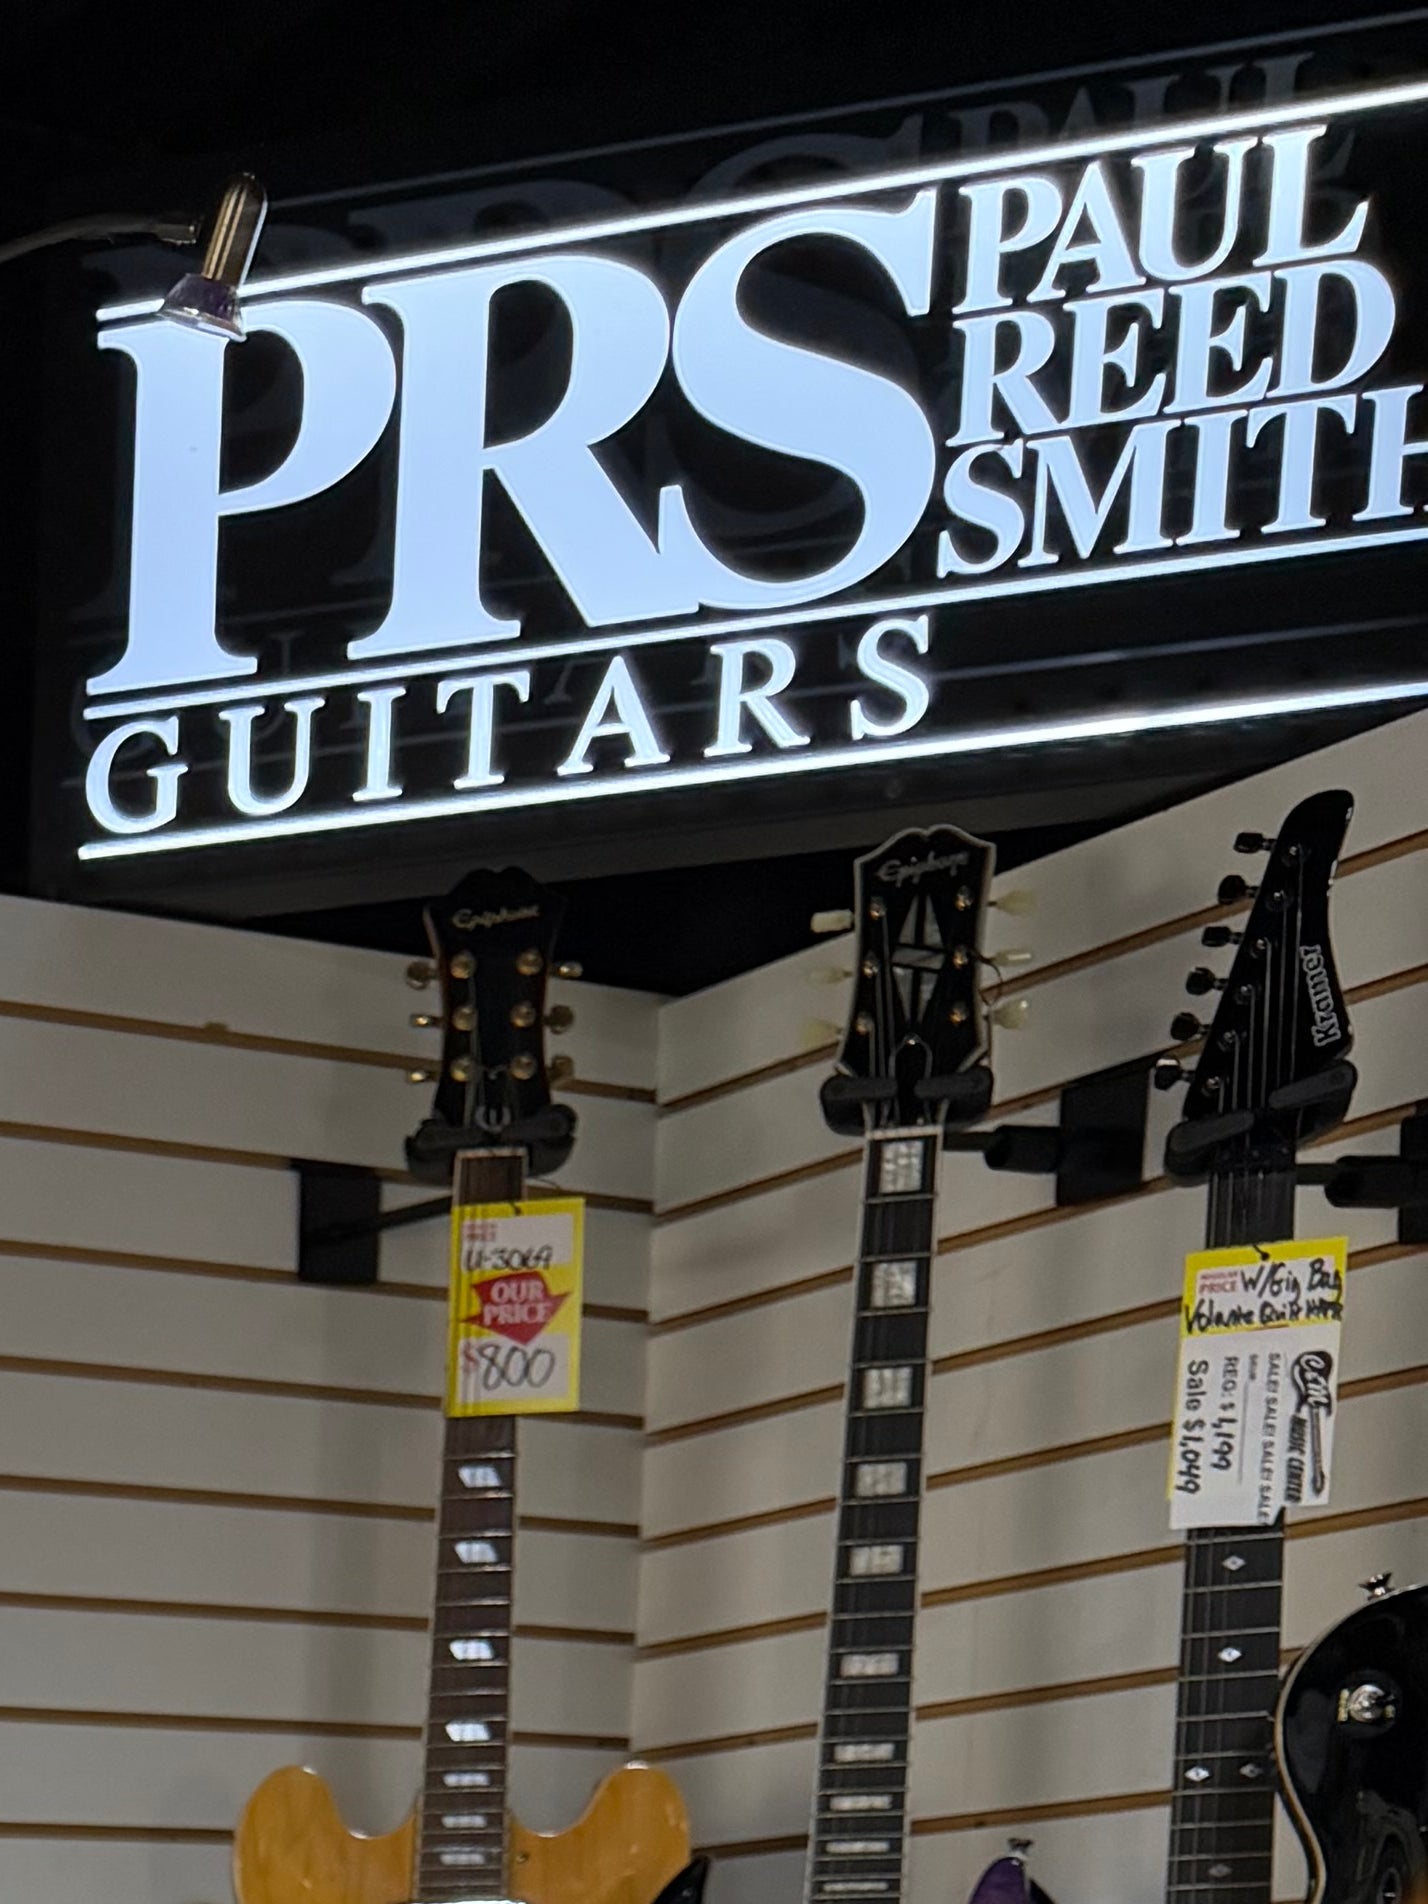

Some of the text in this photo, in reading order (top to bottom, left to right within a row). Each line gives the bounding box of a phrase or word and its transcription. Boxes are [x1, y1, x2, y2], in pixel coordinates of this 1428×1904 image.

[954, 123, 1370, 314] PAUL
[948, 258, 1397, 446] REED
[84, 188, 937, 697] PRS
[84, 614, 931, 836] GUITARS
[1299, 943, 1342, 1048] Kramer
[482, 1301, 554, 1326] PRICE
[490, 1279, 545, 1302] OUR
[1186, 1359, 1209, 1411] Sale
